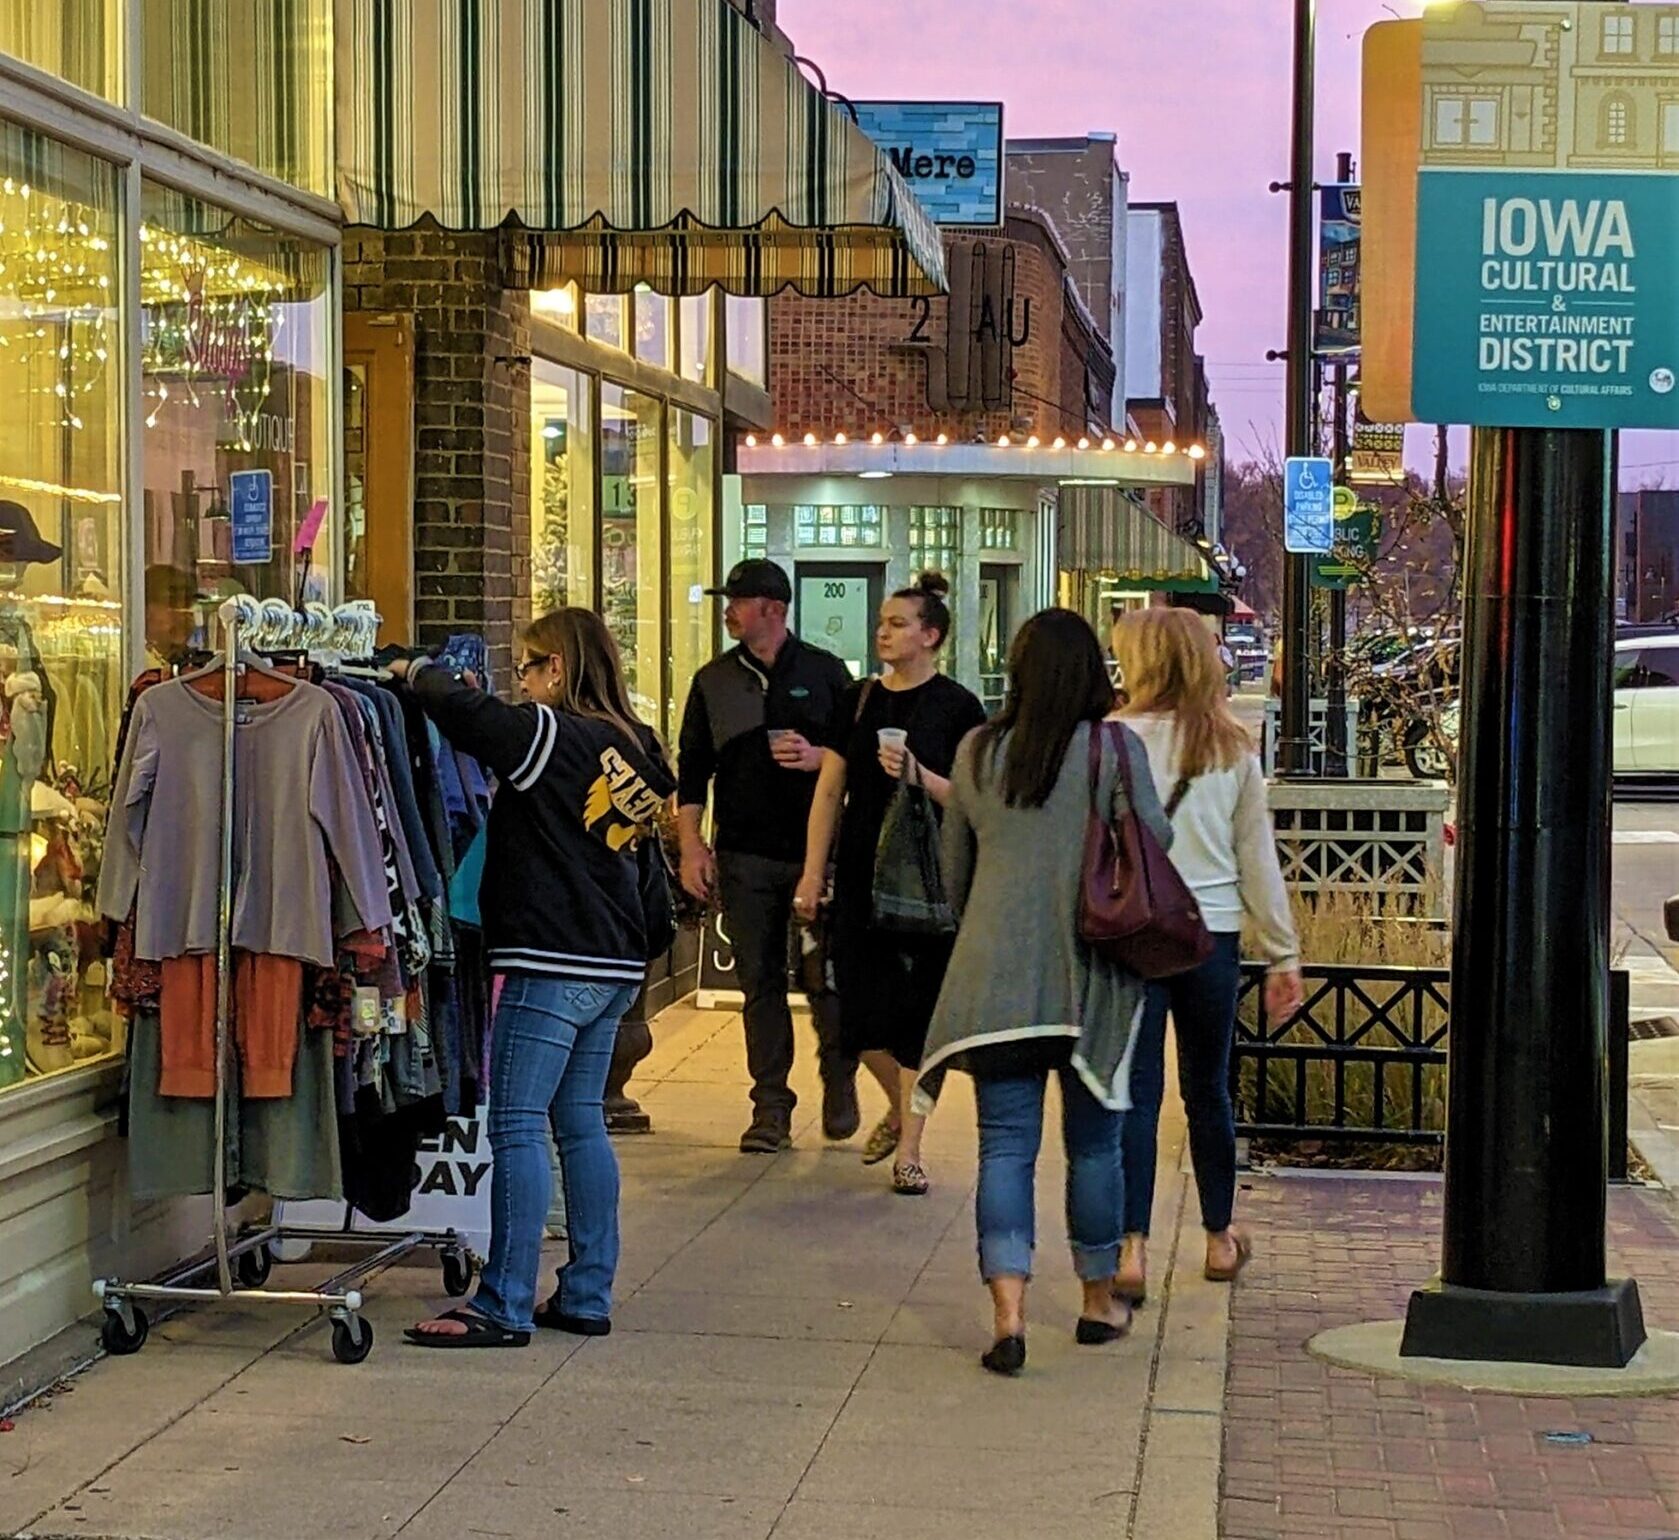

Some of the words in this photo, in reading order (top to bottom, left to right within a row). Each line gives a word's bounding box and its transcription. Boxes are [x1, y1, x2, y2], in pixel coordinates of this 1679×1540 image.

[889, 146, 976, 179] Mere
[1482, 197, 1635, 258] IOWA
[1480, 260, 1636, 293] CULTURAL
[1551, 294, 1567, 312] &
[1479, 314, 1635, 336] ENTERTAINMENT
[1478, 336, 1634, 373] DISTRICT
[1549, 384, 1560, 394] OF
[1560, 384, 1599, 395] CULTURAL
[1600, 385, 1633, 396] AFFAIRS
[1334, 527, 1360, 542] BLIC
[823, 582, 846, 598] 200
[417, 1160, 492, 1196] AY
